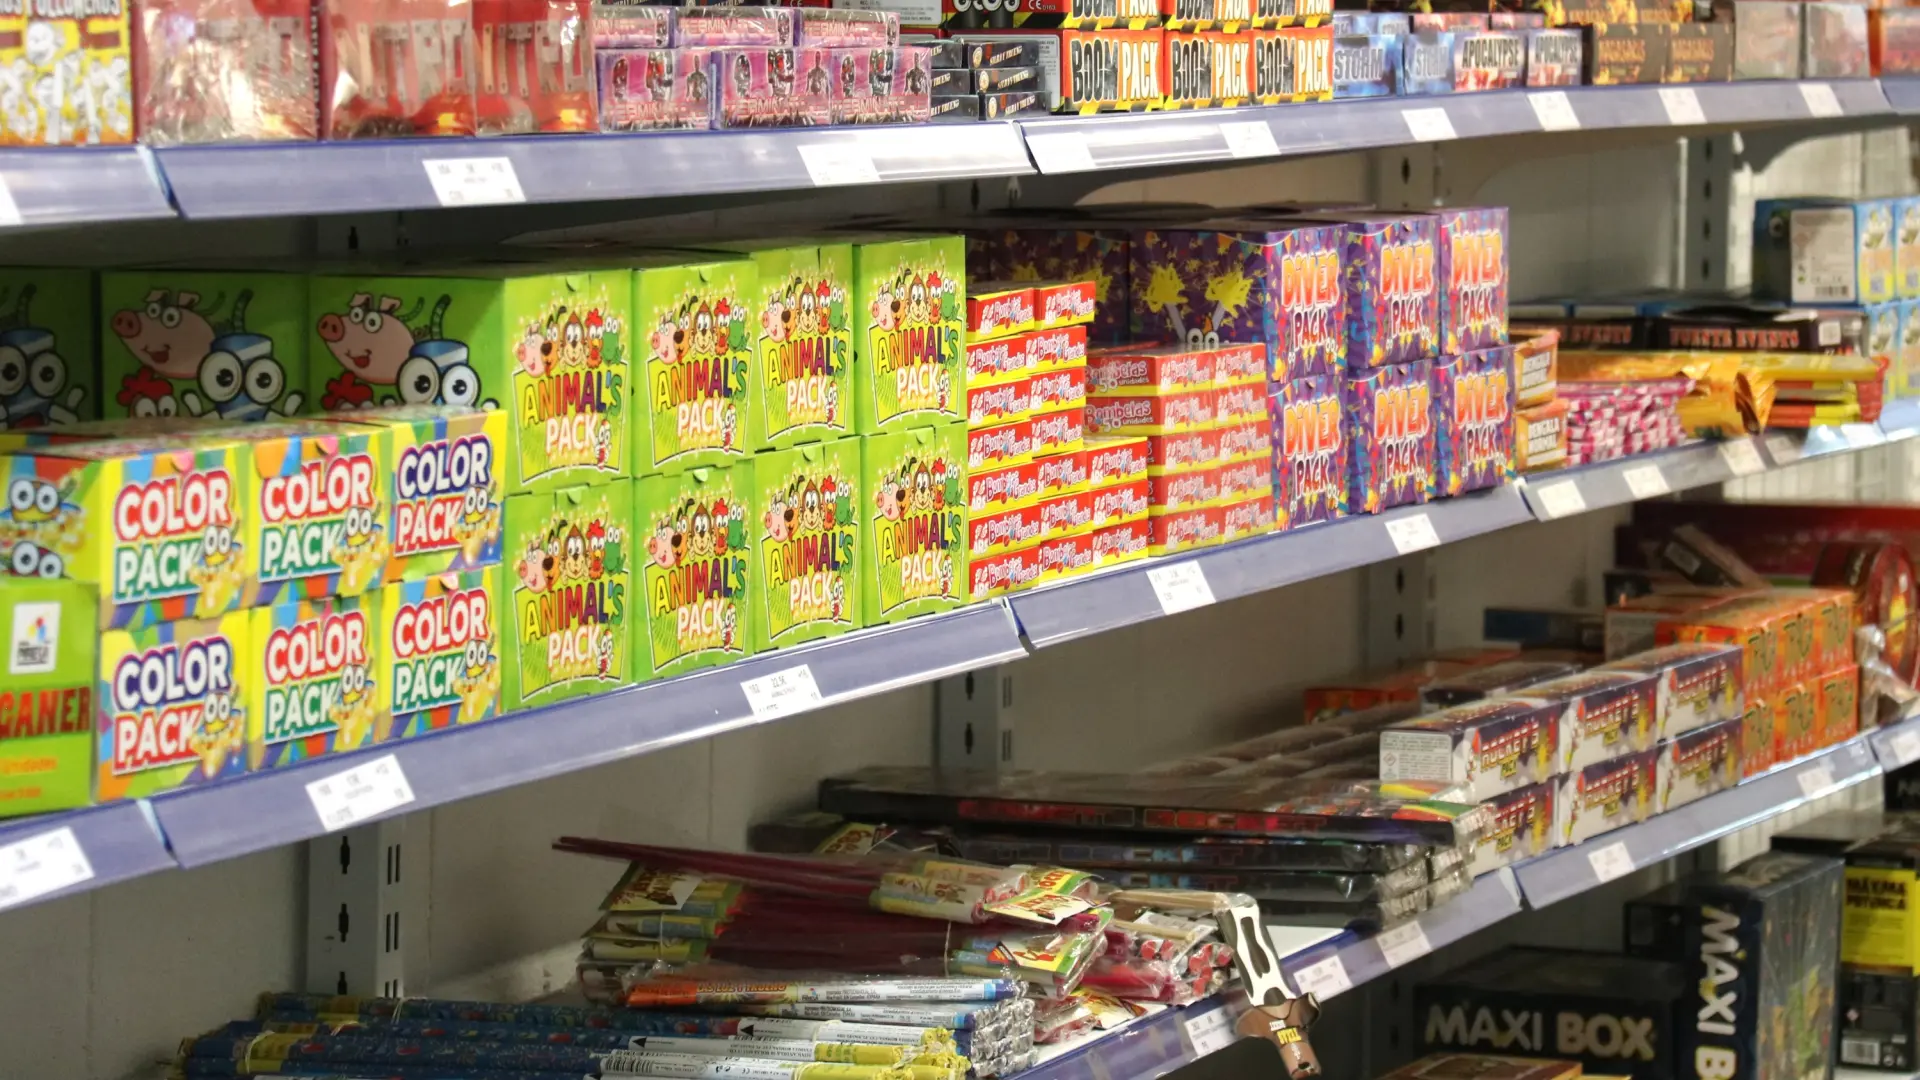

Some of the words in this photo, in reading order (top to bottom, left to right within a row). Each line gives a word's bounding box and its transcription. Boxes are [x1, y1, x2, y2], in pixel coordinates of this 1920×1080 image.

[1071, 37, 1119, 103] BOOM
[1122, 40, 1159, 102] PACK
[1171, 38, 1213, 102] BOOM
[1215, 41, 1249, 99] PACK
[1255, 37, 1296, 99] BOOM
[1298, 39, 1330, 97] PACK
[1334, 47, 1383, 80] STORM
[1462, 38, 1520, 68] APOCALYPSE
[1293, 307, 1328, 352] PACK
[1391, 296, 1423, 339] PACK
[1460, 286, 1493, 328] PACK
[768, 336, 847, 390] ANIMAL'S
[877, 325, 959, 378] ANIMAL'S
[524, 371, 622, 428] ANIMAL'S
[656, 358, 747, 415] ANIMAL'S
[786, 375, 827, 413] PACK
[896, 364, 939, 400] PACK
[546, 412, 599, 454] PACK
[677, 396, 723, 437] PACK
[1086, 400, 1151, 424] Bombetas
[1103, 417, 1121, 432] 50
[399, 439, 490, 497] COLOR
[1385, 439, 1418, 483] PACK
[1466, 425, 1498, 465] PACK
[262, 459, 371, 522] COLOR
[1295, 454, 1329, 500] PACK
[115, 472, 231, 541] COLOR
[397, 497, 464, 548] PACK
[262, 524, 343, 573] PACK
[770, 530, 854, 589] ANIMAL'S
[882, 511, 962, 568] ANIMAL'S
[117, 542, 201, 594] PACK
[655, 557, 747, 616] ANIMAL'S
[790, 571, 833, 609] PACK
[901, 551, 942, 587] PACK
[393, 592, 488, 657] COLOR
[524, 582, 625, 644] ANIMAL'S
[677, 597, 723, 640] PACK
[267, 615, 365, 683] COLOR
[548, 624, 600, 667] PACK
[115, 640, 231, 710] COLOR
[394, 656, 463, 709] PACK
[117, 706, 202, 765] PACK
[267, 682, 340, 736] PACK
[1697, 906, 1742, 1035] MAXI
[1425, 1005, 1543, 1051] MAXI
[1557, 1012, 1657, 1062] BOX
